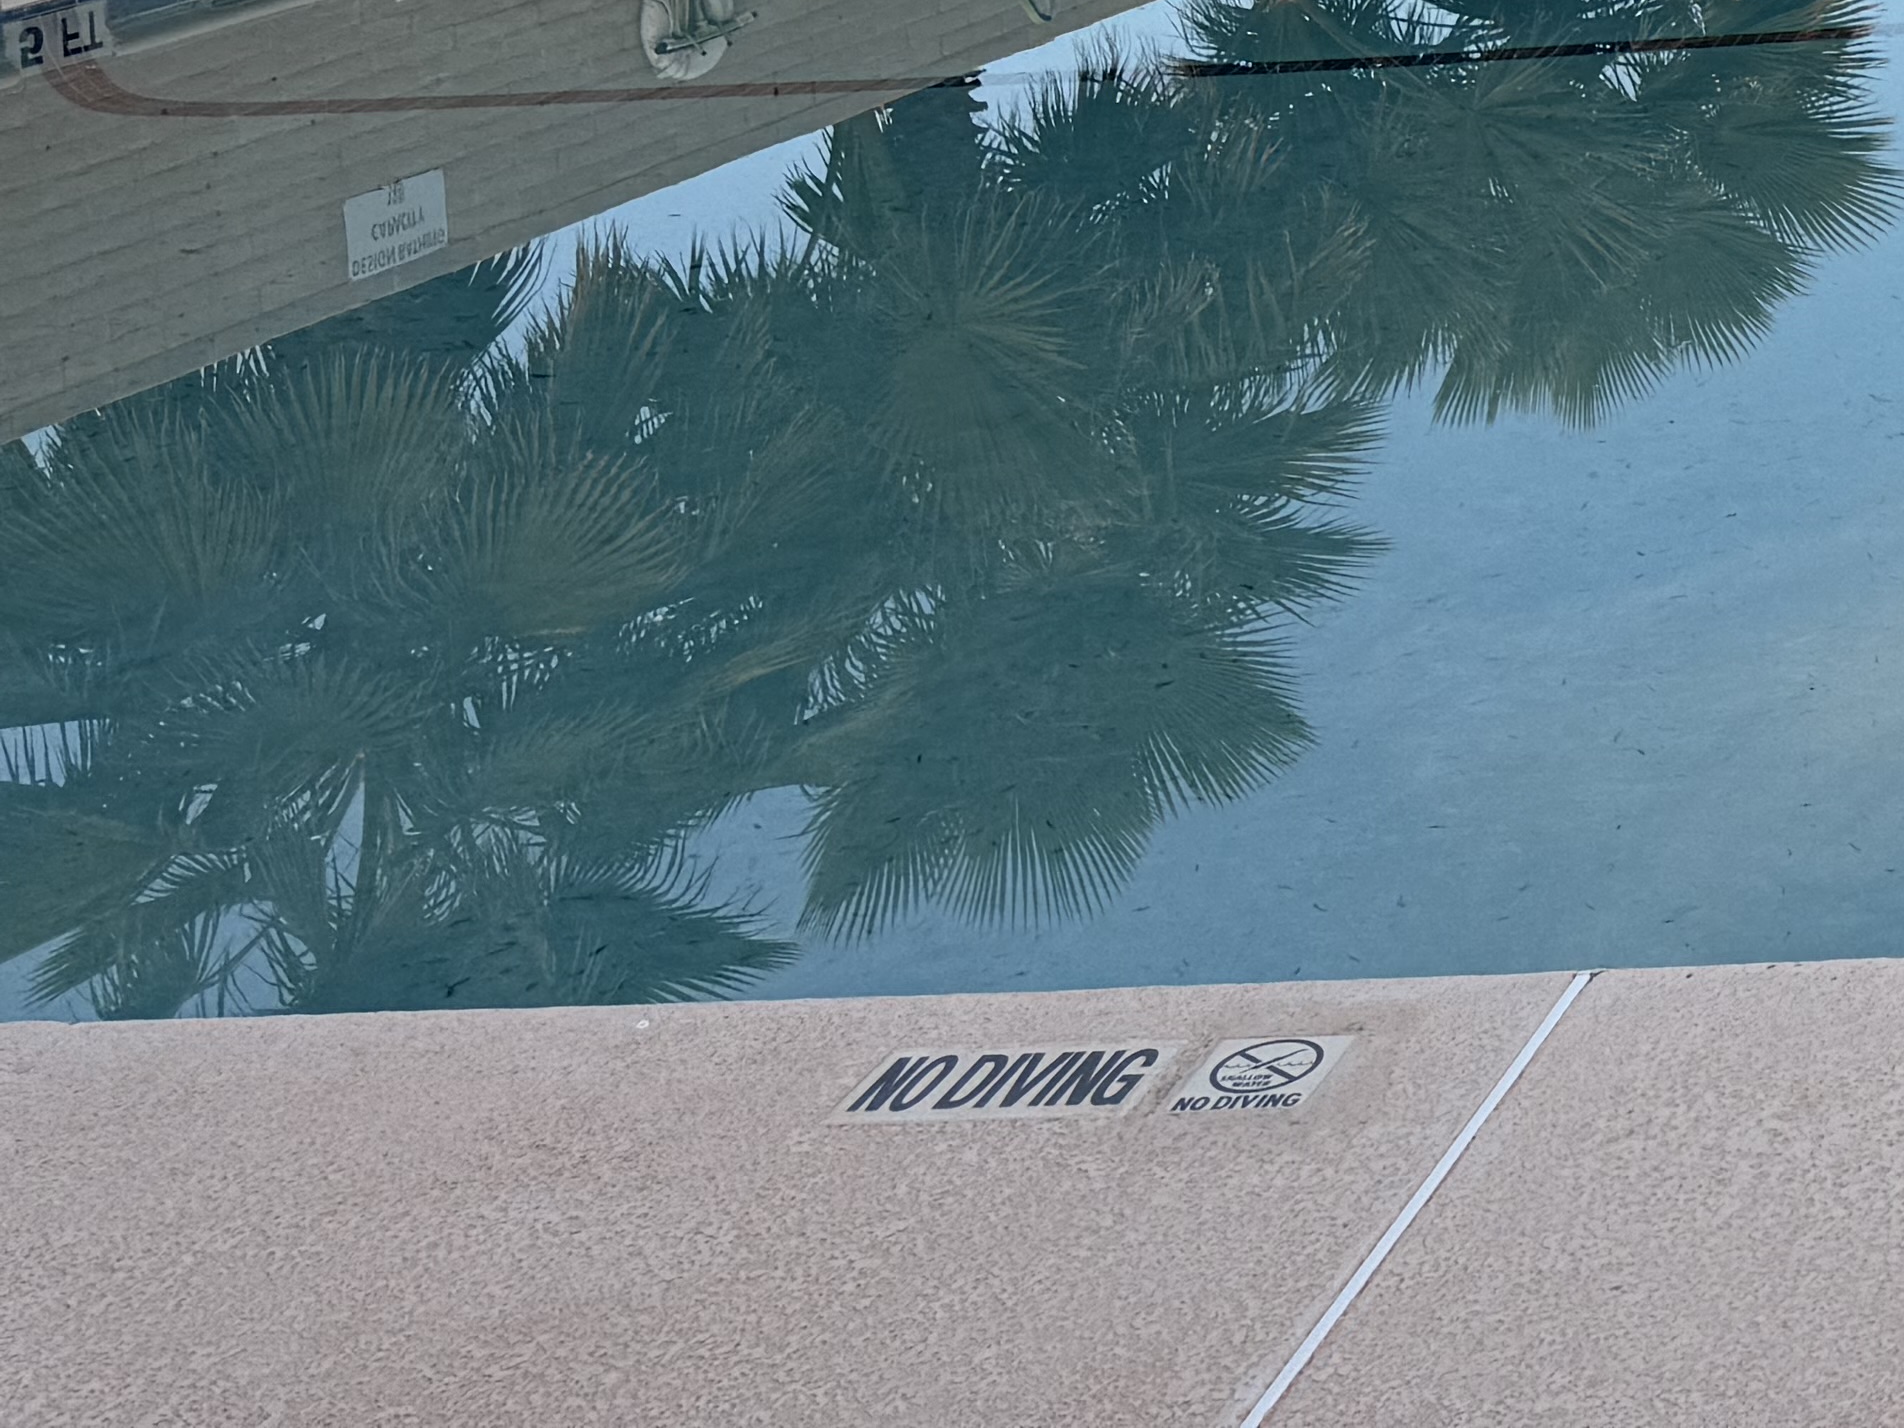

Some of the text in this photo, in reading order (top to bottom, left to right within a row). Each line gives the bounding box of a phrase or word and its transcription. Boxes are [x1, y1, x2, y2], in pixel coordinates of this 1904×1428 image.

[846, 1048, 1159, 1112] NO DIVING
[1170, 1093, 1302, 1111] NO DIVING
